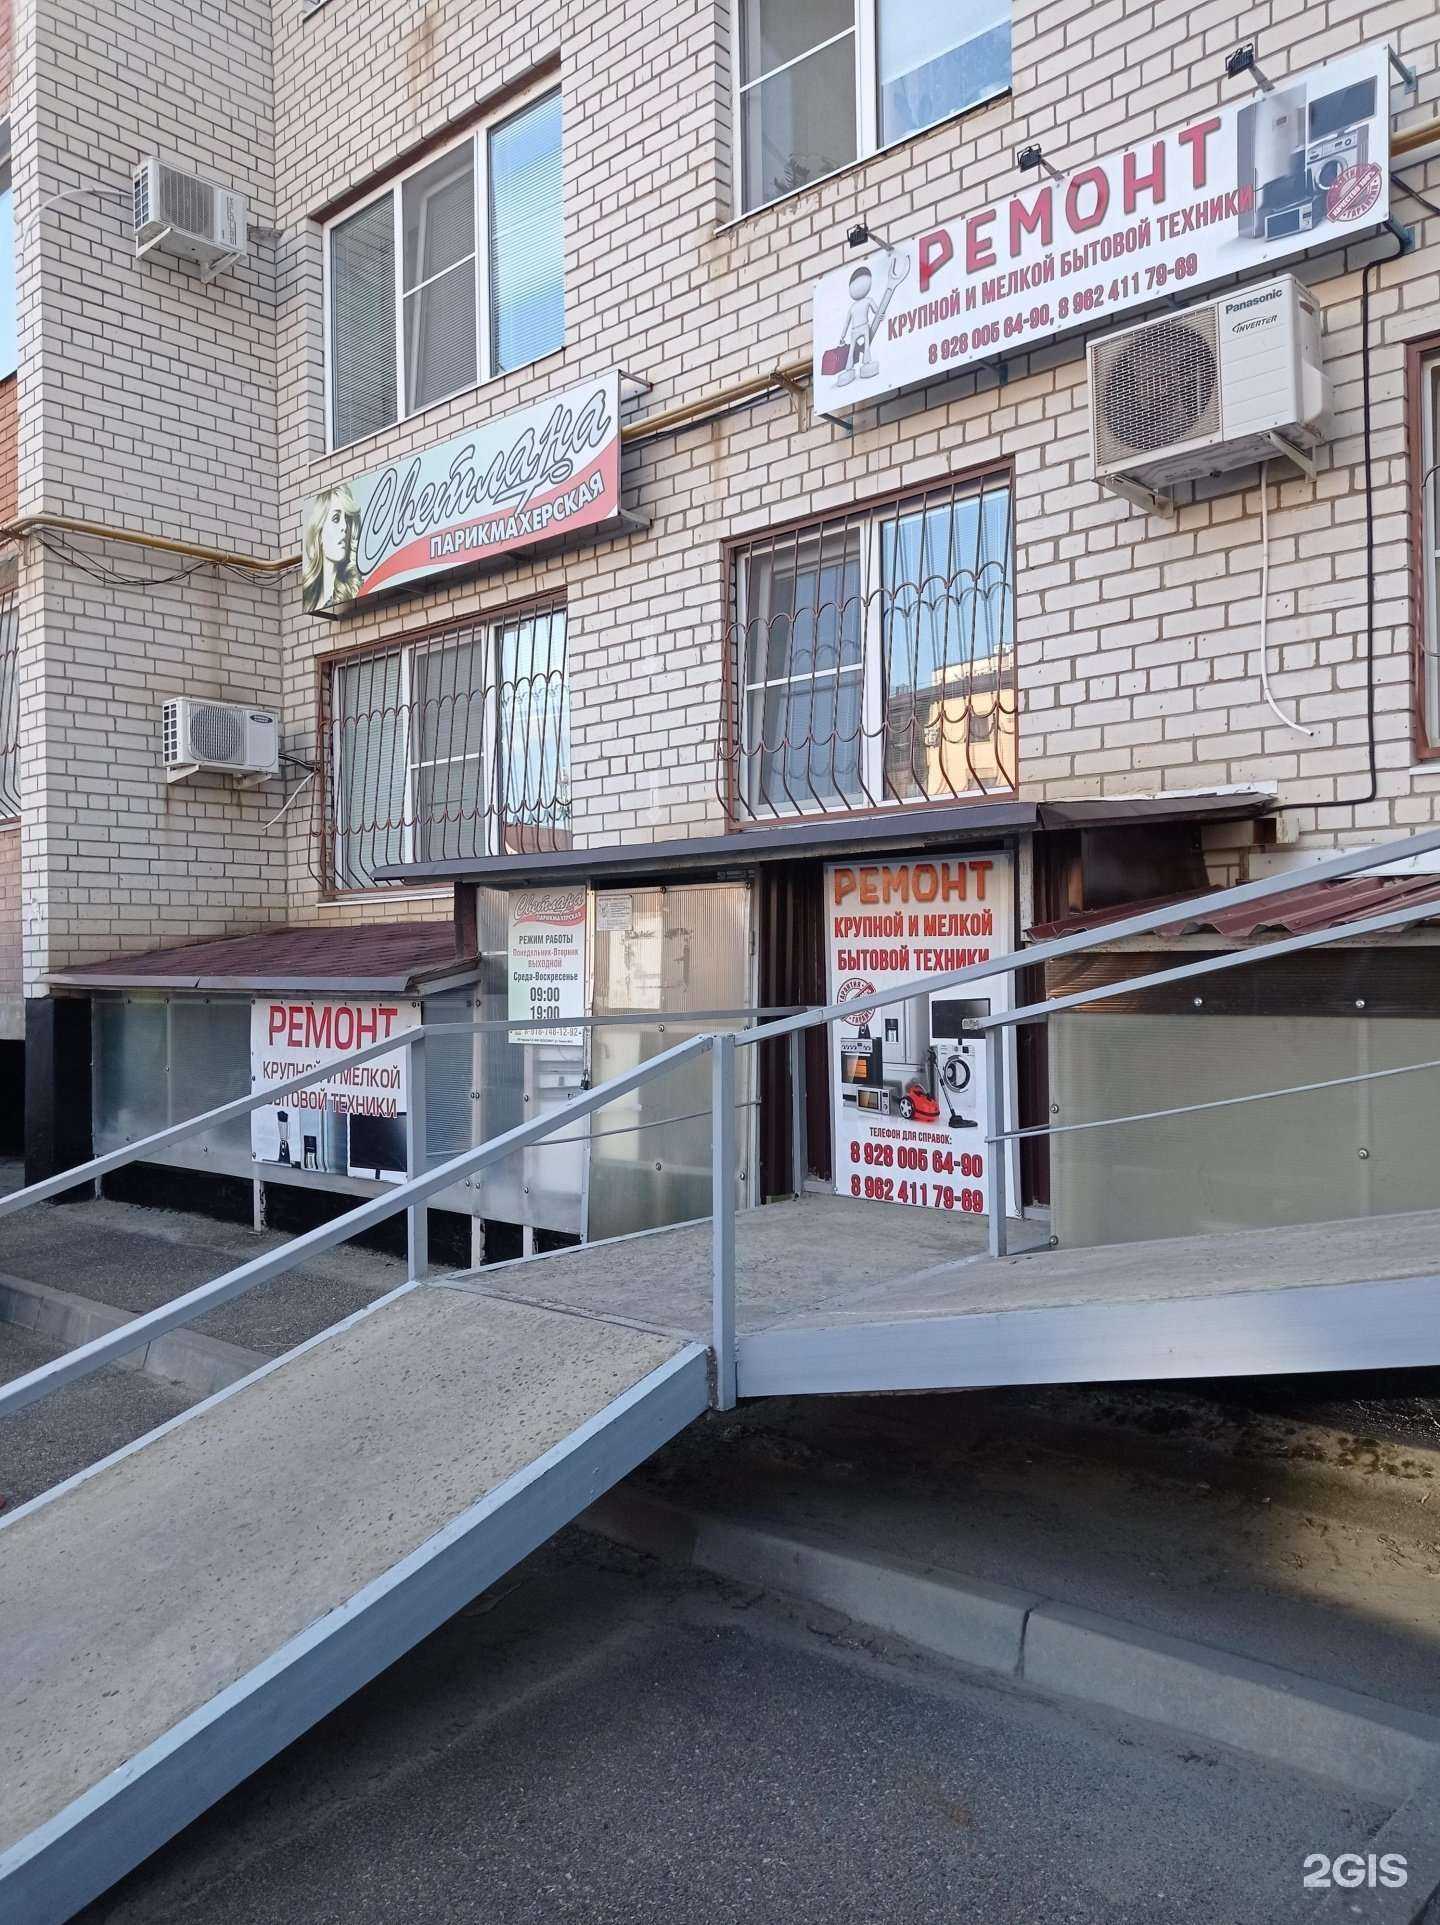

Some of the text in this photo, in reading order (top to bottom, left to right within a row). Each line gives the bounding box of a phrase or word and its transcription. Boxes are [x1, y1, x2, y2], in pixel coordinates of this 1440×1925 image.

[918, 117, 1222, 293] РЕМОНТ
[887, 184, 1255, 341] КРУПНОЙ И МЕЛКОЙ БЫТОВОЙ ТЕХНИКИ
[928, 253, 1198, 364] 8 928 005 64-90, 8 962 411 79-69
[1225, 288, 1283, 315] Panasonic
[1236, 314, 1278, 334] INVERTER
[429, 471, 606, 560] ПАРИКМАХЕРСКАЯ
[834, 860, 994, 906] РЕМОНТ
[834, 908, 993, 938] КРУПНОЙ И МЕЛКОЙ
[519, 934, 574, 945] РЕЖИМ РАБОТЫ
[837, 945, 990, 971] БЫТОВОЙ ТЕХНИКИ
[513, 972, 578, 983] Среда-Воскресенье
[530, 987, 560, 1001] 09:00
[268, 1005, 398, 1050] РЕМОНТ
[530, 1006, 560, 1019] 19:00
[339, 1065, 401, 1089] МЕЛКОЙ
[268, 1087, 398, 1119] ЫТОВОЙ ТЕХНИКИ
[869, 1127, 952, 1145] ТЕЛЕФОН ДЛЯ СПРАВОК:
[850, 1141, 983, 1178] 8 928 005 64-90
[850, 1174, 984, 1213] 8 962 411 79-69
